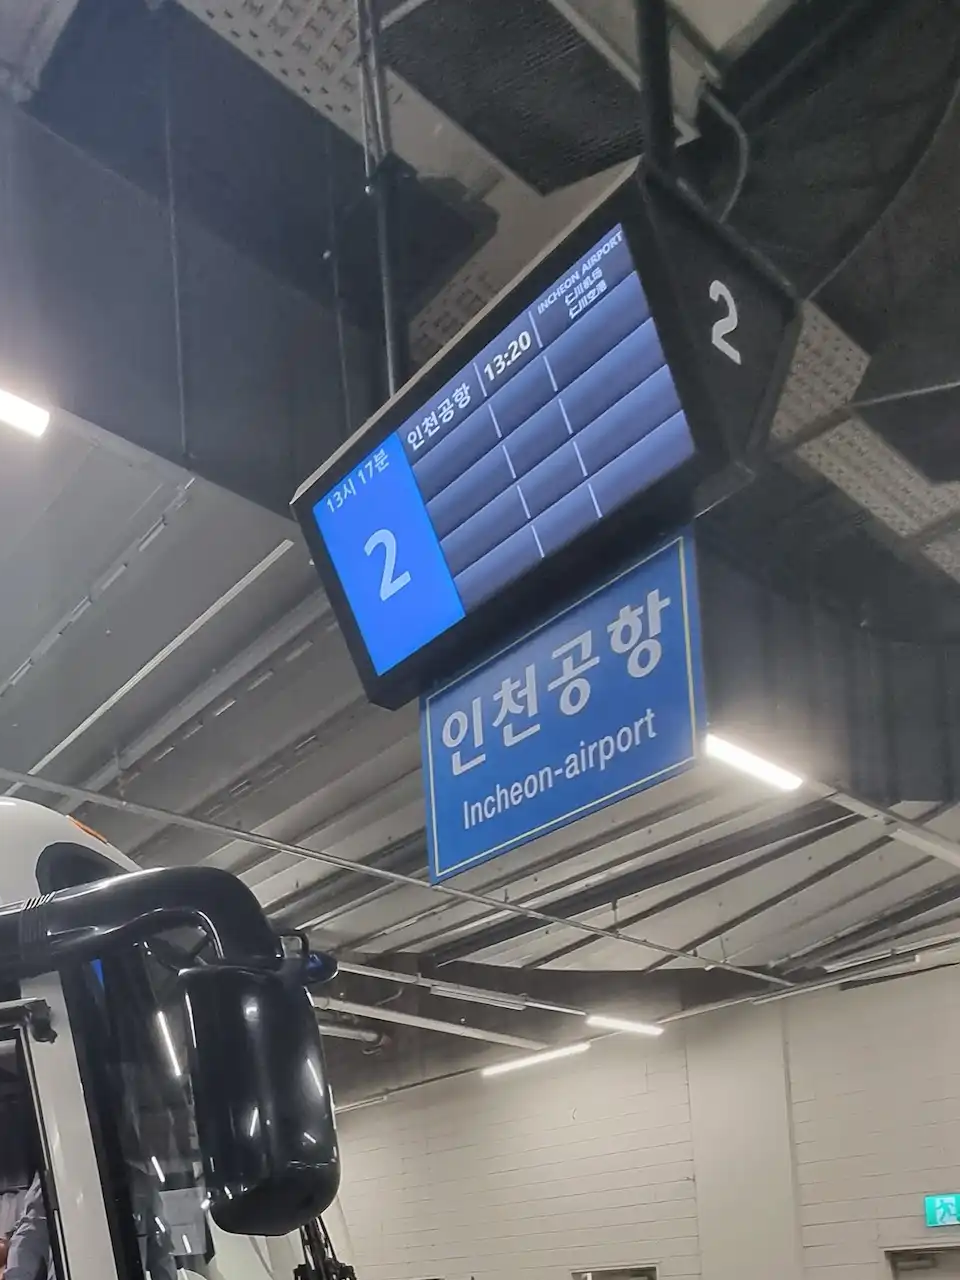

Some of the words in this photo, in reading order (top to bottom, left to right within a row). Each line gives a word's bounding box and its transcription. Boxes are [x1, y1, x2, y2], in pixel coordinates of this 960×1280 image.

[537, 270, 580, 315] INCHEON
[582, 229, 623, 275] AIRPORT
[709, 280, 741, 365] 2
[406, 382, 472, 451] 인천공항
[483, 330, 532, 381] 13:20
[326, 477, 357, 514] 13시
[357, 448, 390, 485] 17분
[363, 528, 411, 601] 2
[442, 588, 671, 776] 인천공항
[463, 708, 658, 830] Incheon-airport
